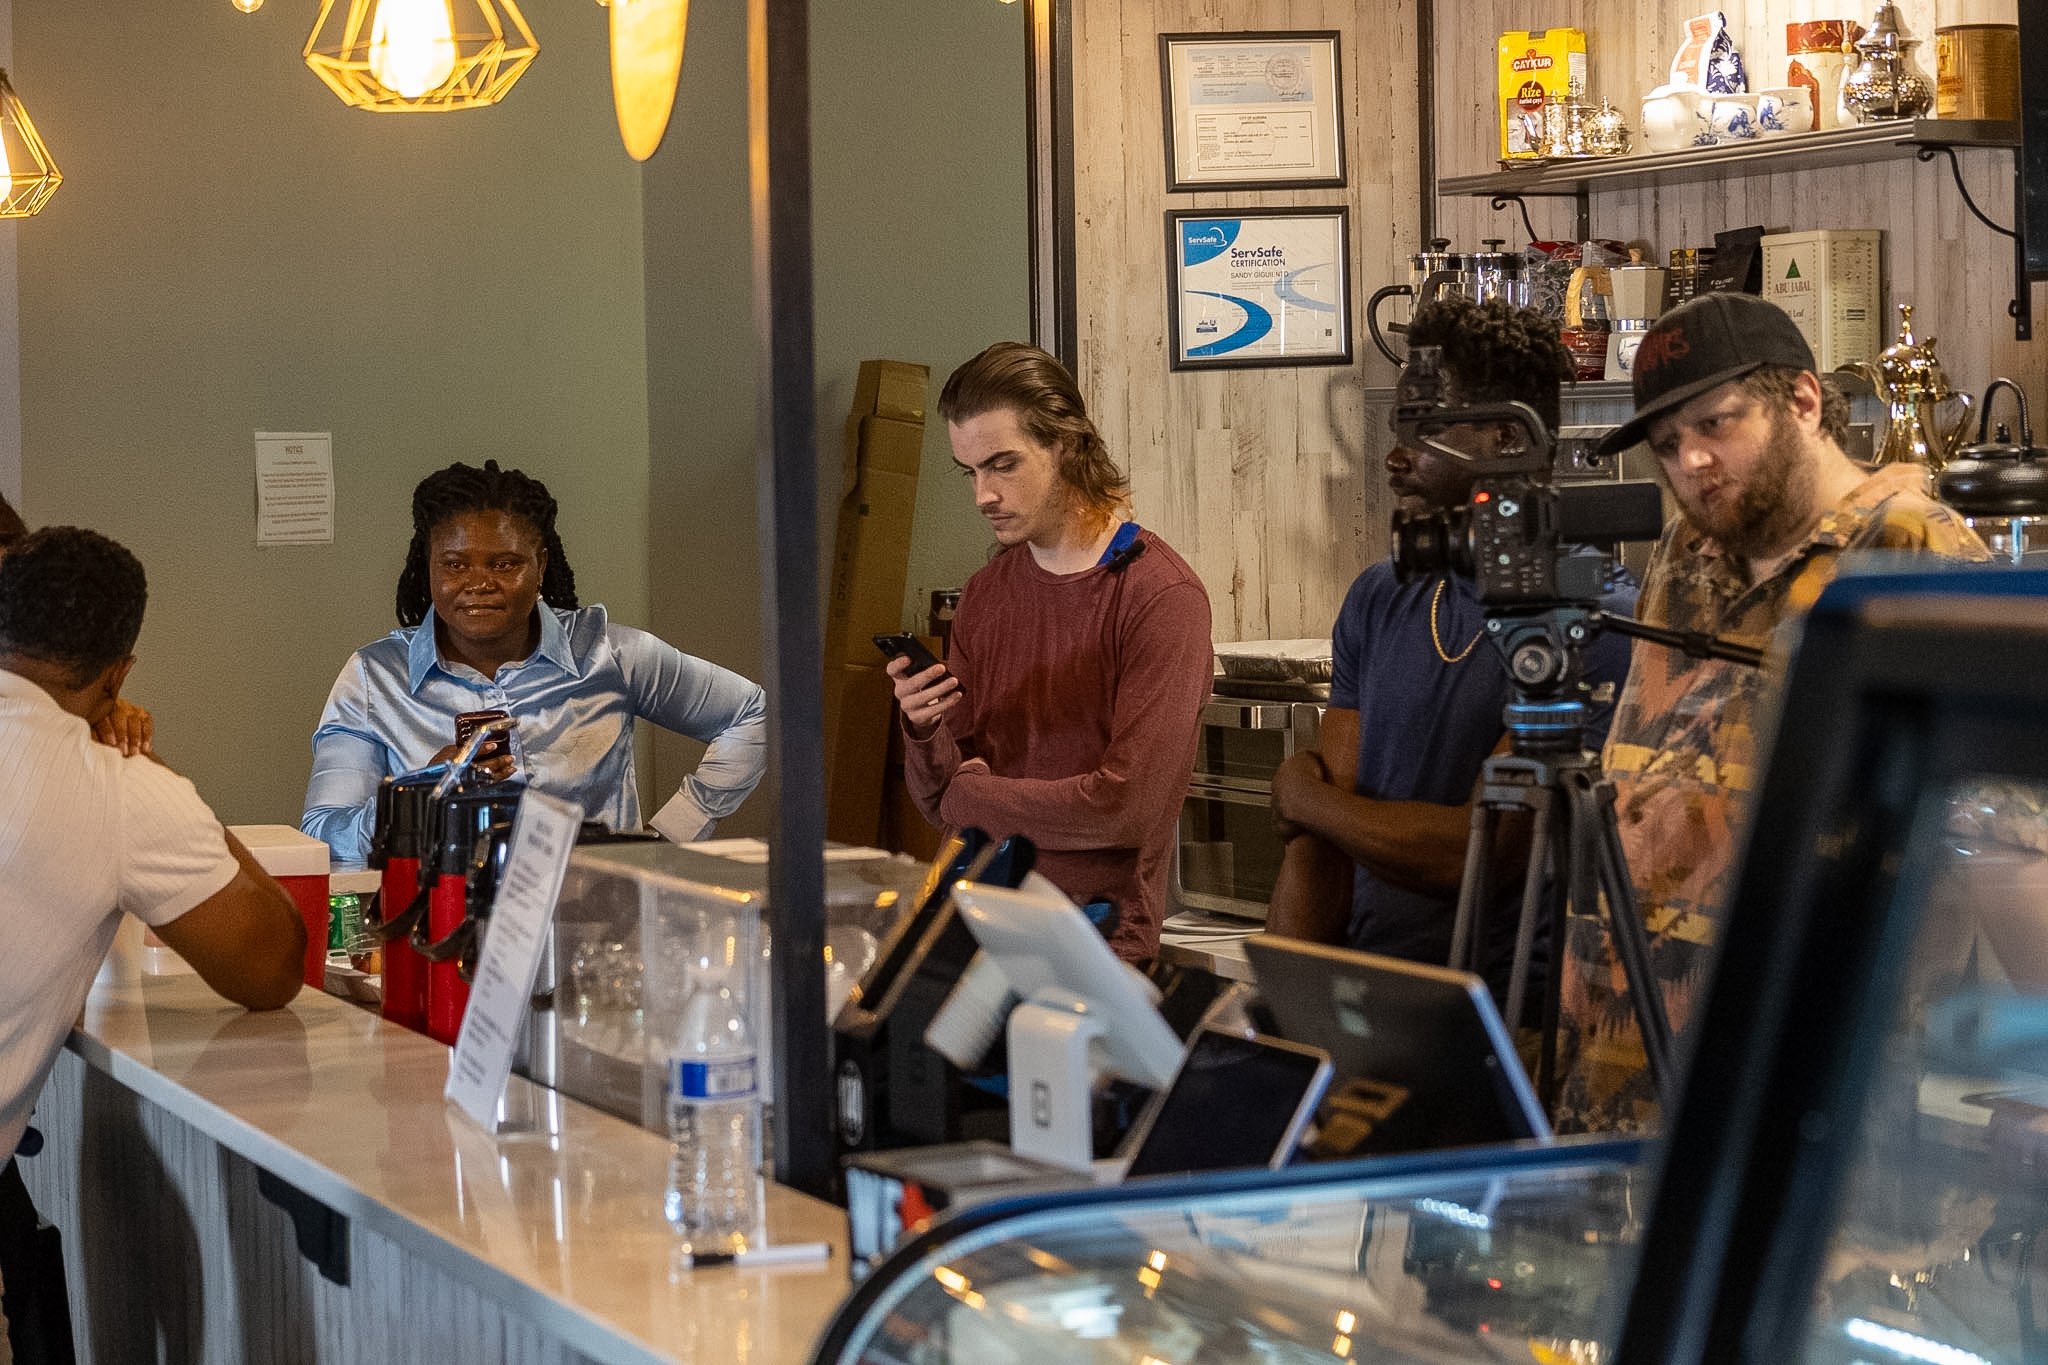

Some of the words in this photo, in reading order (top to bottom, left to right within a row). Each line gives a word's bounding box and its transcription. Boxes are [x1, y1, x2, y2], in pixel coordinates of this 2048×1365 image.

[1513, 57, 1552, 71] ÇAYKUR
[1521, 87, 1541, 98] Rize
[1188, 236, 1217, 244] ServSafe
[1231, 246, 1283, 258] ServSafe
[1230, 258, 1286, 267] CERTIFICATION
[1230, 271, 1253, 279] SANDY
